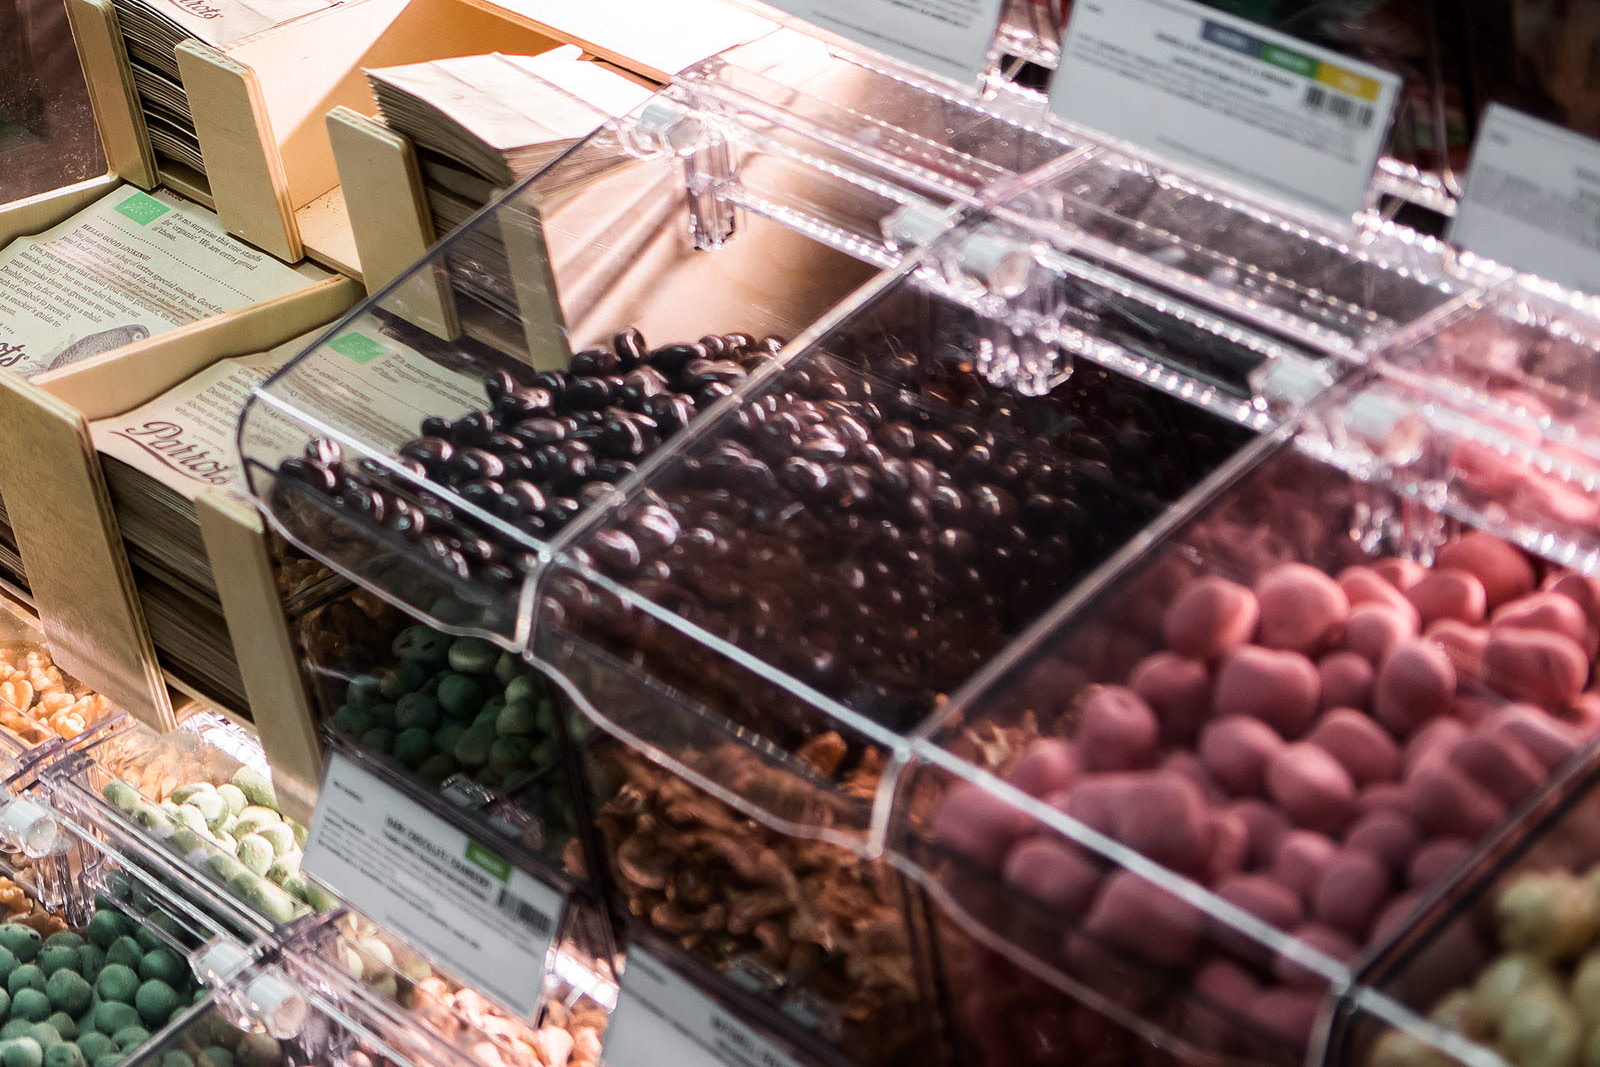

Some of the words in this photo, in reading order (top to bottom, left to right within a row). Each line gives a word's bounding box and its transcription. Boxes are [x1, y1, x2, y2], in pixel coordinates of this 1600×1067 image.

[81, 223, 104, 237] HELLO
[102, 235, 122, 247] GOOD
[119, 245, 151, 261] LOOKING!
[158, 228, 176, 241] those.
[161, 219, 173, 227] for
[199, 238, 210, 247] We
[208, 245, 221, 253] are
[219, 251, 237, 263] extra
[233, 260, 258, 271] proud
[171, 212, 184, 221] It's
[181, 218, 192, 226] no
[190, 223, 217, 239] surprise
[215, 236, 230, 246] this
[228, 244, 242, 253] one
[240, 251, 263, 262] stands
[0, 265, 23, 280] Double
[19, 277, 37, 287] yay!
[33, 283, 45, 291] In
[40, 287, 55, 298] fact,
[54, 295, 65, 303] we
[63, 298, 80, 311] have
[82, 311, 102, 324] whole
[9, 259, 26, 269] nuts
[29, 269, 48, 281] make
[46, 278, 64, 290] them
[67, 291, 88, 303] green
[93, 303, 105, 312] we
[102, 309, 116, 319] can.
[19, 252, 42, 266] snacks,
[41, 263, 61, 275] okay)
[62, 272, 75, 283] but
[72, 279, 84, 287] we
[81, 285, 94, 293] are
[91, 290, 107, 300] also
[104, 295, 131, 313] busting
[127, 309, 141, 318] our
[41, 251, 57, 261] you
[54, 257, 67, 267] can
[65, 263, 78, 272] say
[76, 268, 91, 278] that
[88, 275, 108, 287] about
[104, 284, 124, 295] your
[120, 292, 136, 302] own
[132, 298, 164, 316] product,
[160, 312, 173, 321] we
[81, 236, 98, 246] just
[118, 254, 133, 265] bag
[136, 264, 154, 276] extra
[152, 274, 178, 289] special
[173, 286, 197, 301] snacks.
[196, 297, 217, 310] Good
[109, 262, 125, 272] also
[120, 269, 141, 279] good
[136, 276, 149, 284] for
[146, 282, 159, 290] the
[158, 288, 180, 301] world.
[178, 298, 192, 309] You
[8, 283, 20, 291] of
[14, 287, 41, 302] symbols
[44, 303, 65, 316] prove
[63, 312, 72, 321] it.
[8, 297, 38, 313] snacker's
[34, 311, 54, 323] guide
[52, 320, 61, 328] to
[123, 420, 232, 485] Parrots
